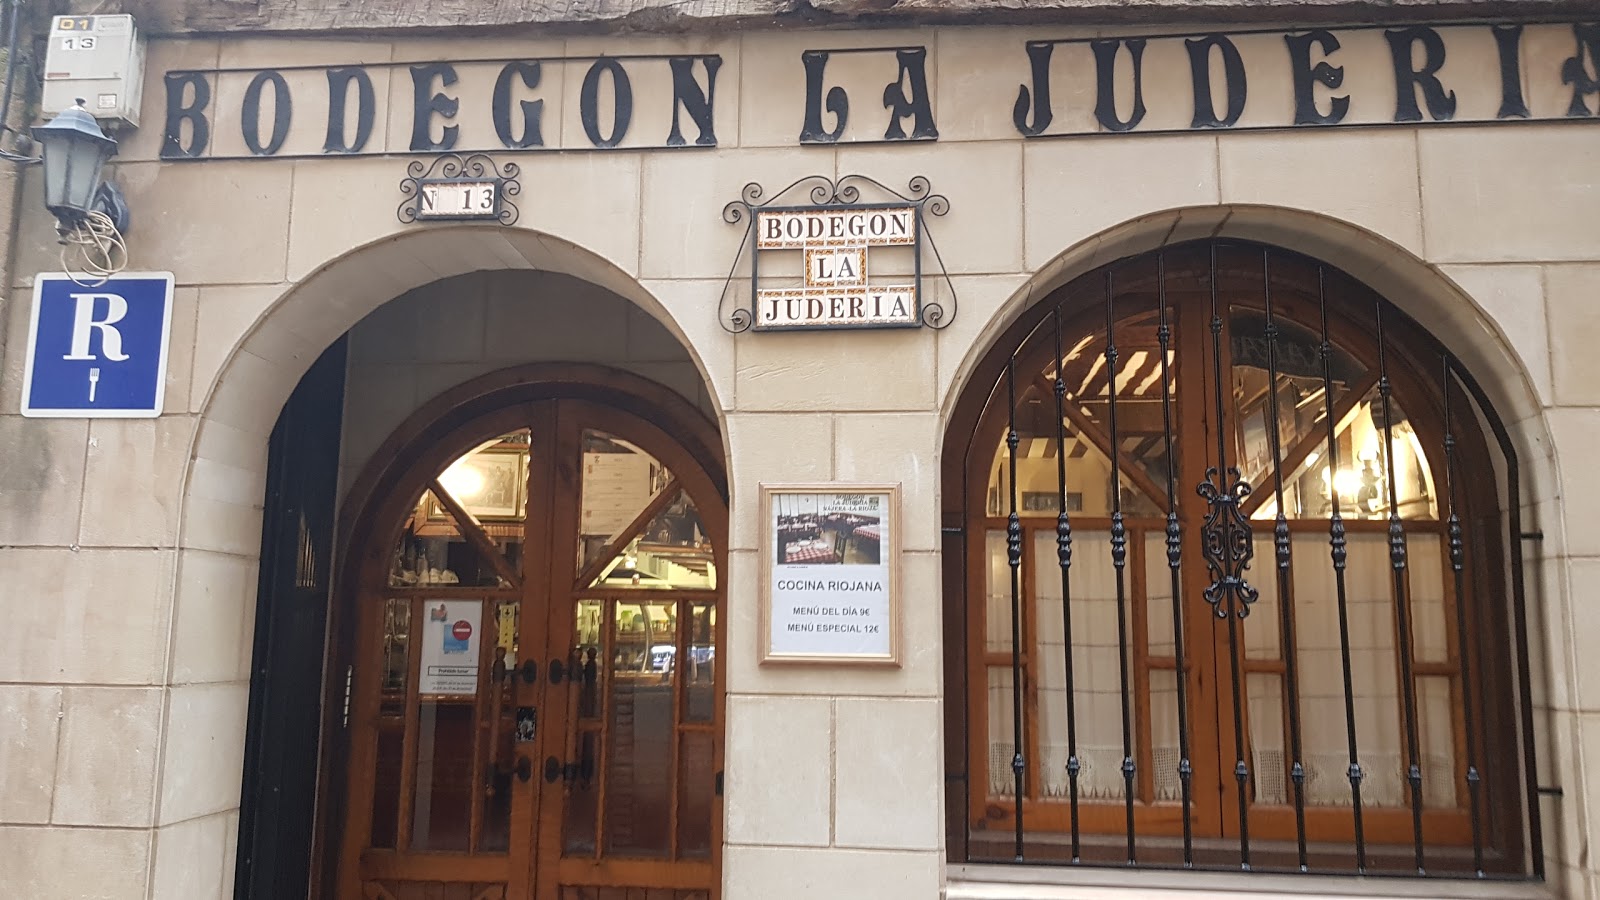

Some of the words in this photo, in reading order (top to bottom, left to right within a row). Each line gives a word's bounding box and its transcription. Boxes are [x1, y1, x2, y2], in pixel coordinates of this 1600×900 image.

[64, 38, 94, 49] 13
[160, 56, 722, 159] BODEGON
[799, 46, 939, 145] LA
[1013, 22, 1600, 138] JUDERIA
[462, 188, 494, 210] 13
[765, 213, 908, 239] BODEGON
[816, 256, 856, 279] LA
[765, 295, 909, 321] JUDERIA
[63, 293, 130, 362] R
[777, 580, 825, 591] COCINA
[828, 581, 882, 592] RIOJANA
[793, 605, 820, 616] MENÚ
[822, 607, 840, 616] DEL
[842, 606, 858, 616] DÍA
[859, 608, 871, 616] 9€
[787, 621, 814, 632] MENÚ
[816, 624, 861, 633] ESPECIAL
[863, 625, 880, 634] 12€
